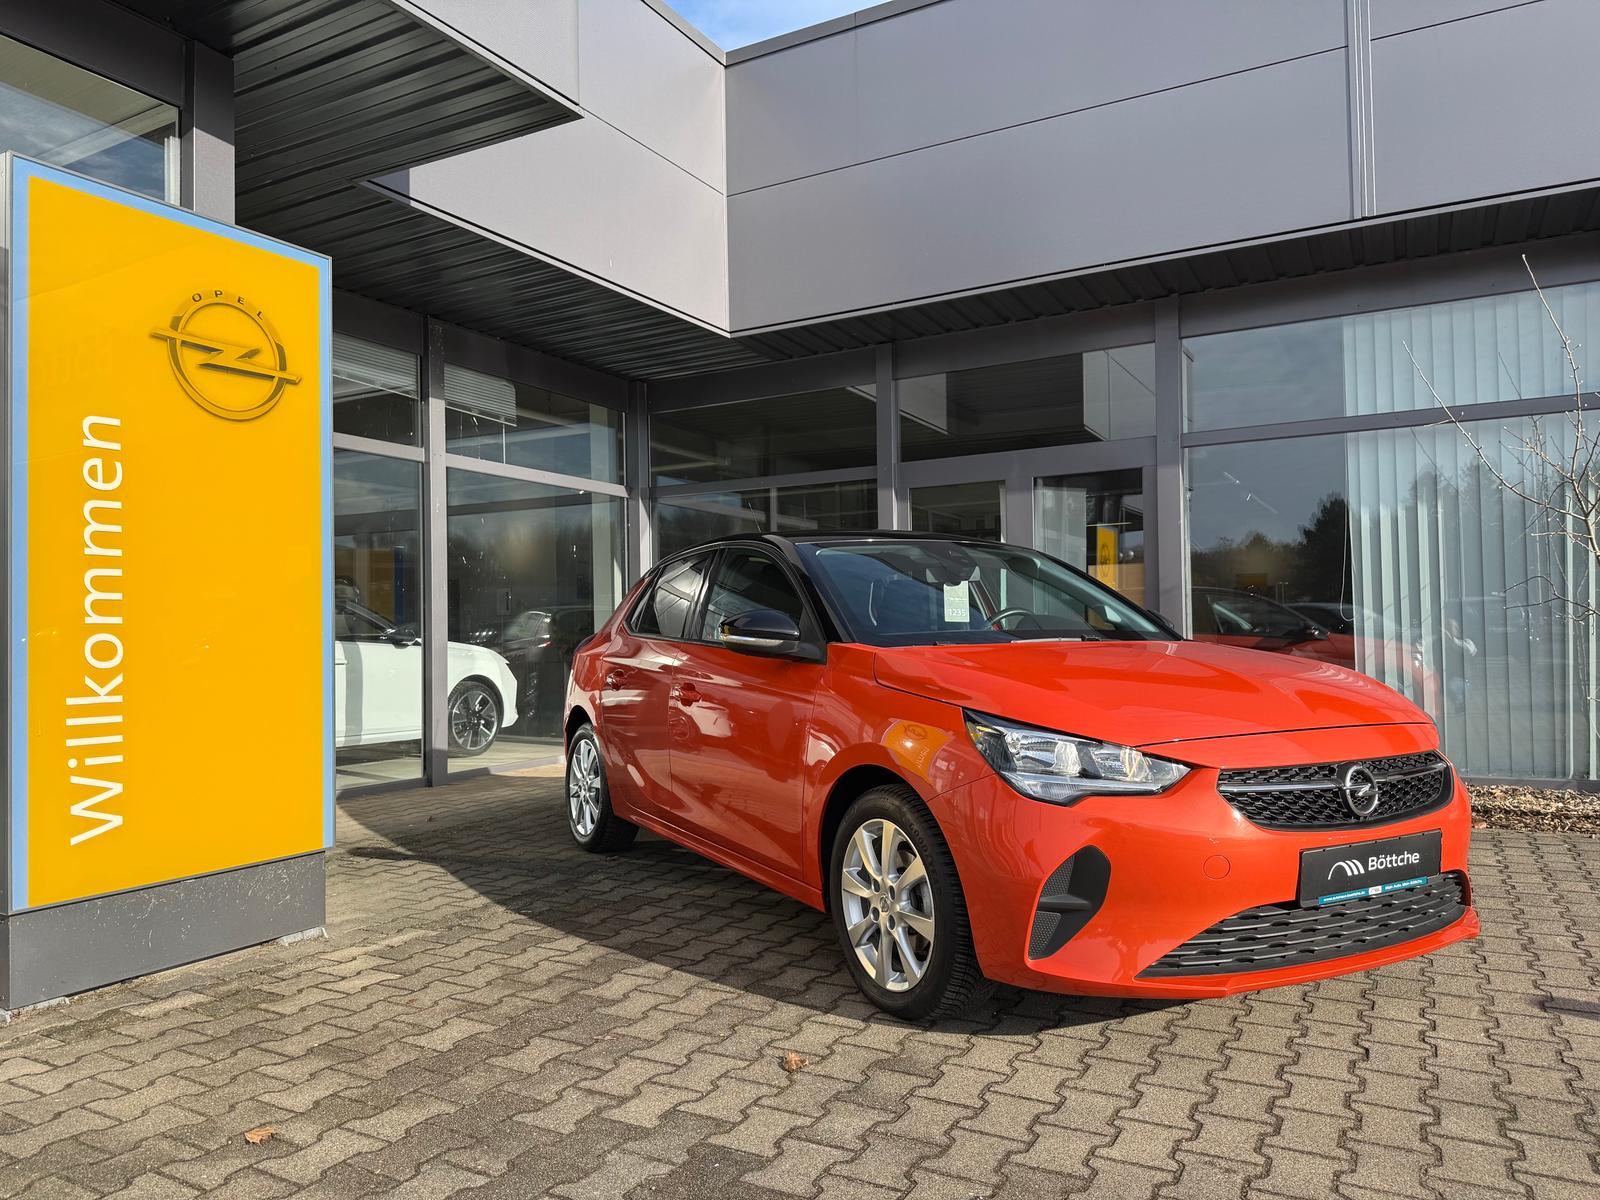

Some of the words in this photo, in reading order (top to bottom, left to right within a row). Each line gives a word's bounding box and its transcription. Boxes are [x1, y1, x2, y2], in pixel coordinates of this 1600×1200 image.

[192, 289, 264, 321] OPEL
[65, 414, 124, 846] Willkommen
[1368, 851, 1420, 870] Böttche
